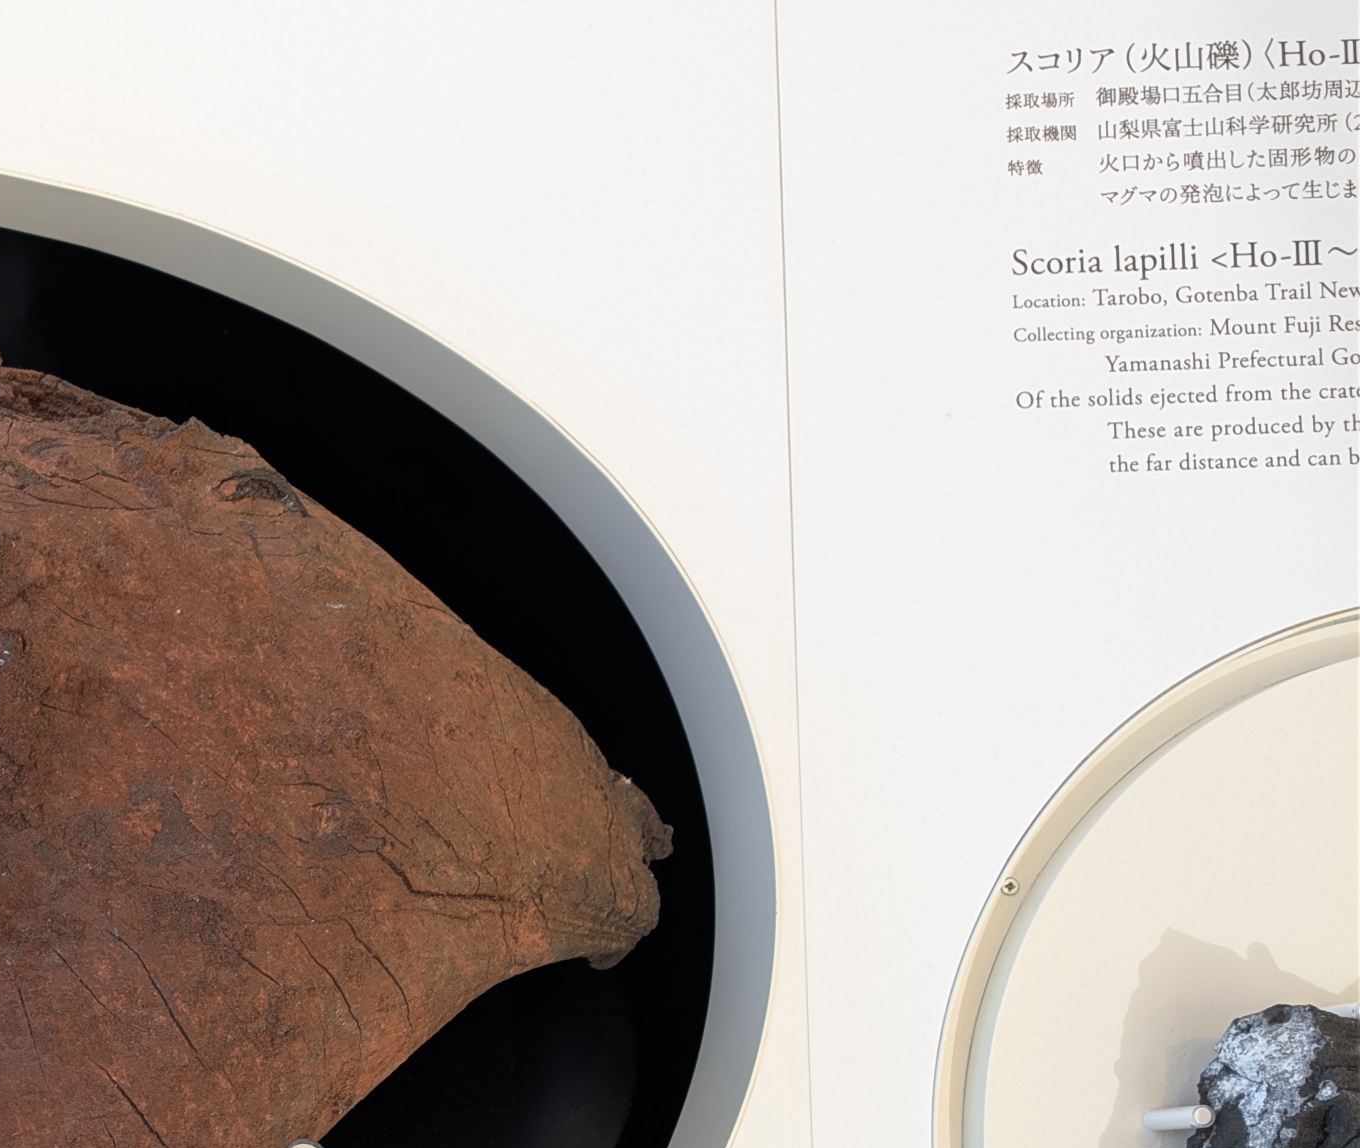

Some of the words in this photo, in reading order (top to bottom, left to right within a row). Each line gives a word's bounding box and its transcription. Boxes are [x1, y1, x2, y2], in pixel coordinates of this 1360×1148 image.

[1005, 92, 1074, 110] 採取場所
[1007, 125, 1076, 143] 採取機関
[1008, 159, 1043, 176] 特徴
[1100, 146, 1356, 173] 火口から噴出した固形物の
[1101, 179, 1357, 205] マグマの発泡によって生じま
[1012, 249, 1103, 275] Scoria
[1114, 242, 1198, 280] lapilli
[1013, 294, 1085, 309] Location:
[1092, 287, 1167, 306] Tarobo,
[1176, 283, 1259, 303] Gotenba
[1265, 281, 1312, 300] Trail
[1014, 327, 1095, 344] Collecting
[1100, 324, 1201, 343] organization:
[1210, 318, 1276, 335] Mount
[1284, 316, 1321, 338] Fuji
[1105, 352, 1210, 372] Yamanashi
[1218, 348, 1324, 368] Prefectural
[1332, 348, 1360, 365] Go
